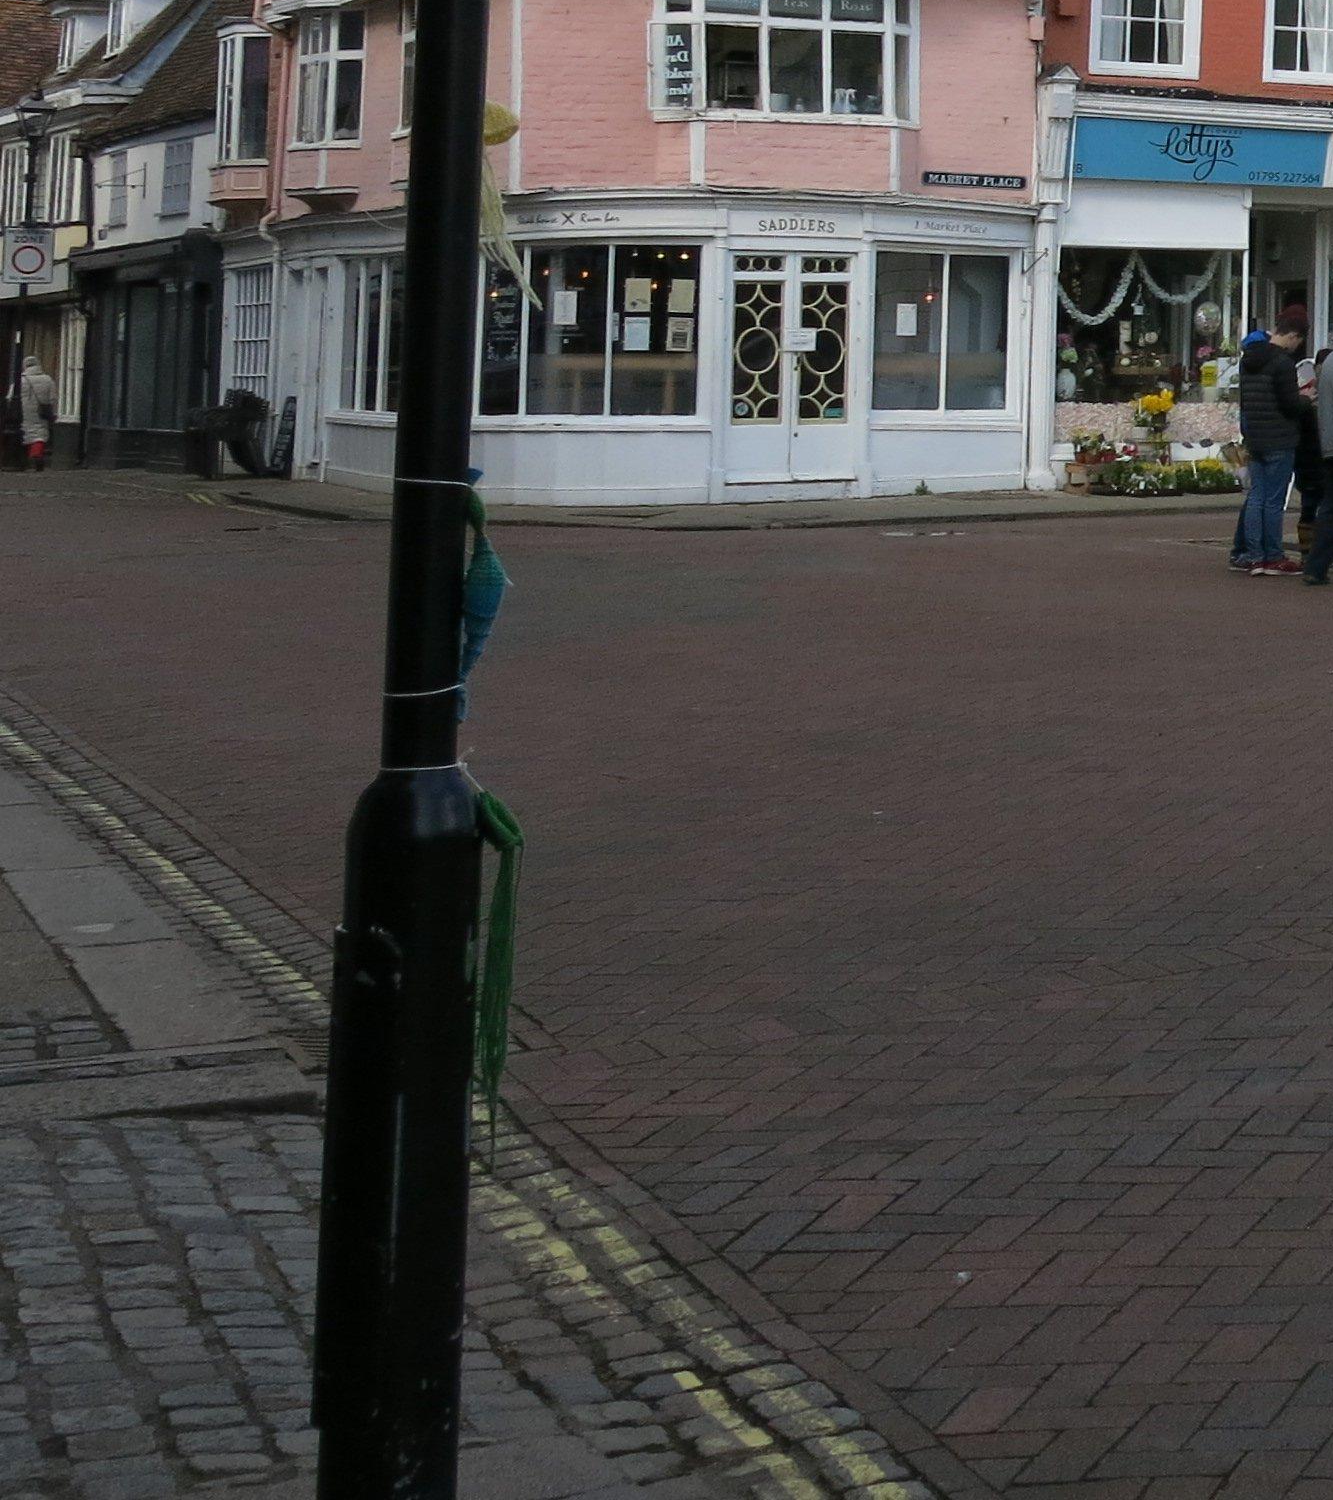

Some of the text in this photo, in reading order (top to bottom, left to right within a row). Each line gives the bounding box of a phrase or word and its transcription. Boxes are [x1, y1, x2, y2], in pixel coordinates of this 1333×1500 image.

[1148, 125, 1241, 181] Lotty's
[928, 173, 1022, 188] MARKET PLACE
[1248, 171, 1320, 184] 01795 227564
[757, 218, 836, 234] SADDLERS
